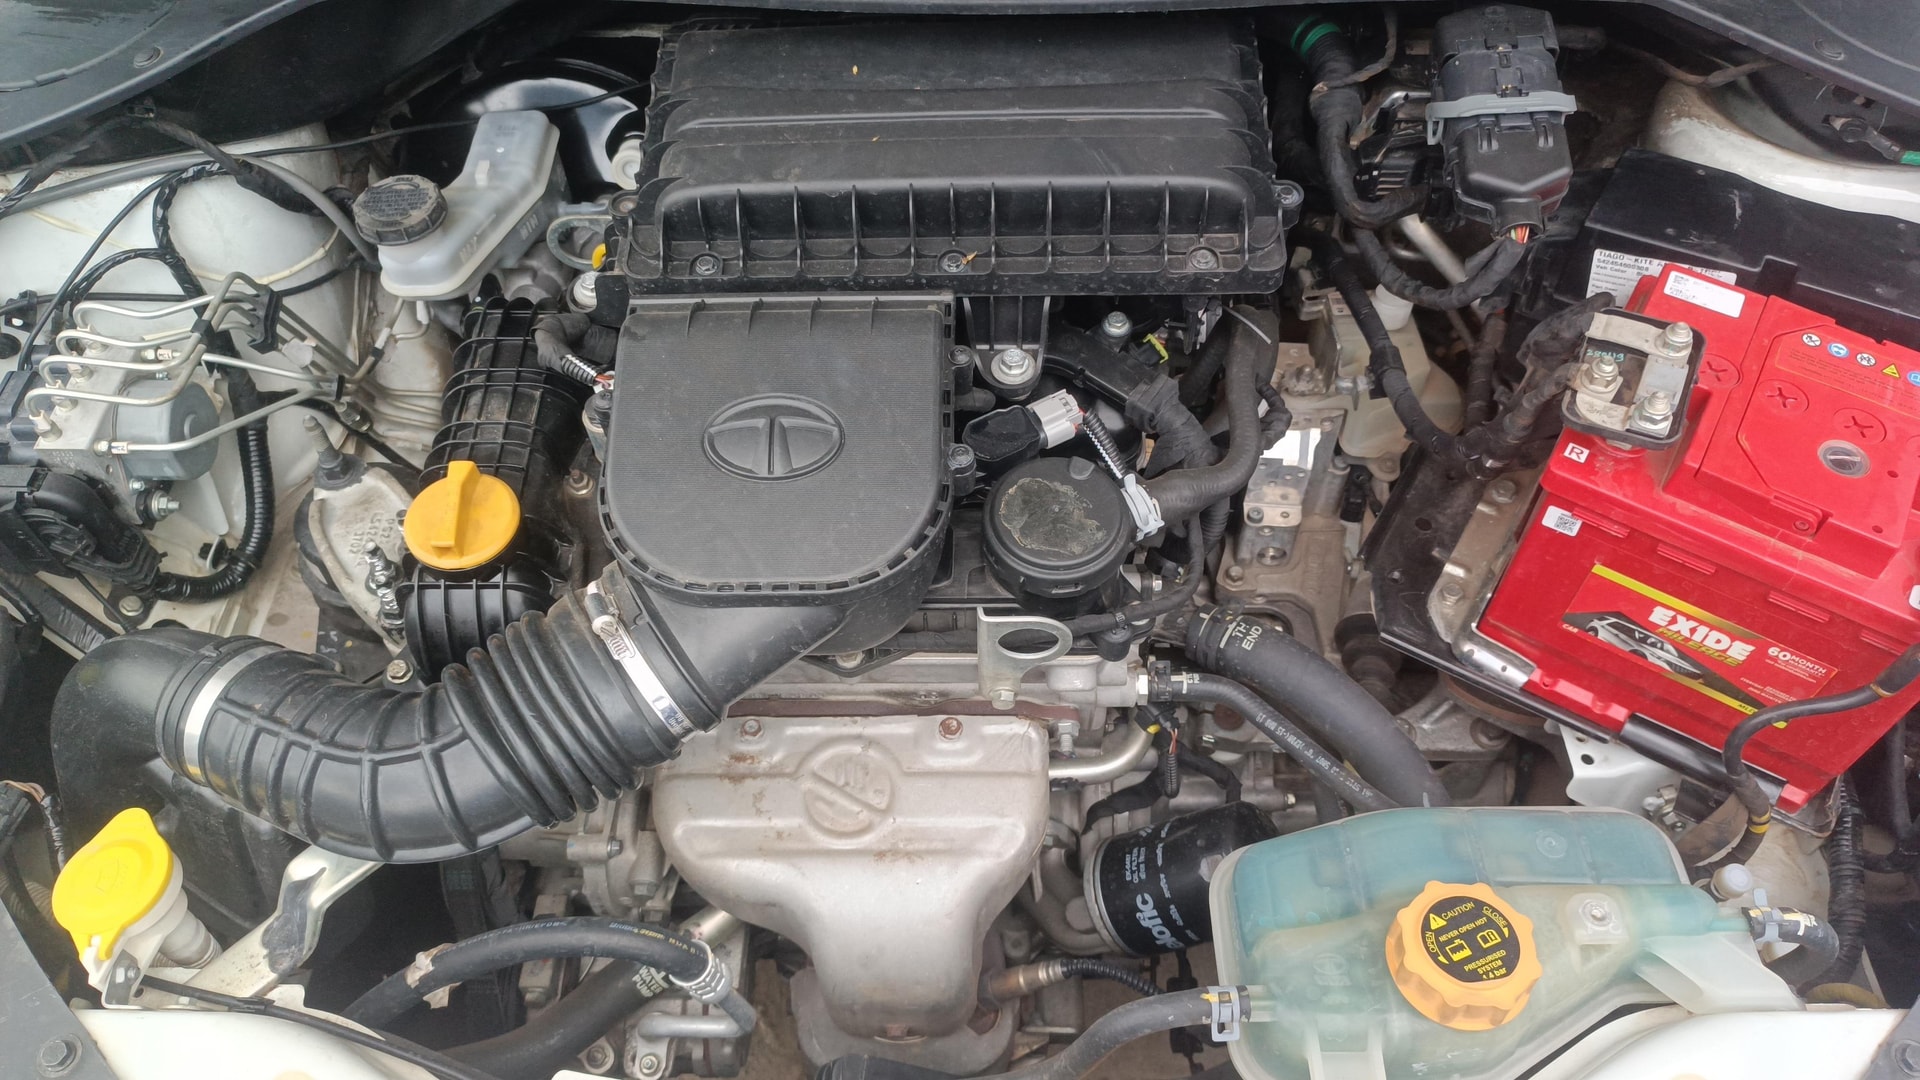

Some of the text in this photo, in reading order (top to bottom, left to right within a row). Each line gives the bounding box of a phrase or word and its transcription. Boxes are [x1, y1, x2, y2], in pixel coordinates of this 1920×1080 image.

[1599, 250, 1625, 262] TIAGO
[1634, 257, 1654, 266] KITE
[1568, 445, 1584, 460] R
[1241, 625, 1263, 651] END
[1648, 605, 1756, 661] EXIDE
[1655, 627, 1745, 667] MILEAGE
[1767, 646, 1828, 674] 60 MONTH
[1441, 901, 1475, 920] CAUTION
[1482, 905, 1508, 929] CLOSE
[1438, 916, 1488, 942] NEVER OPEN HOT
[1425, 931, 1437, 953] OPEN
[1463, 949, 1507, 972] PRESSURISED
[1477, 959, 1503, 974] SYSTEM
[1494, 967, 1507, 977] bar
[631, 974, 654, 998] PUMP
[639, 964, 664, 994] WATER
